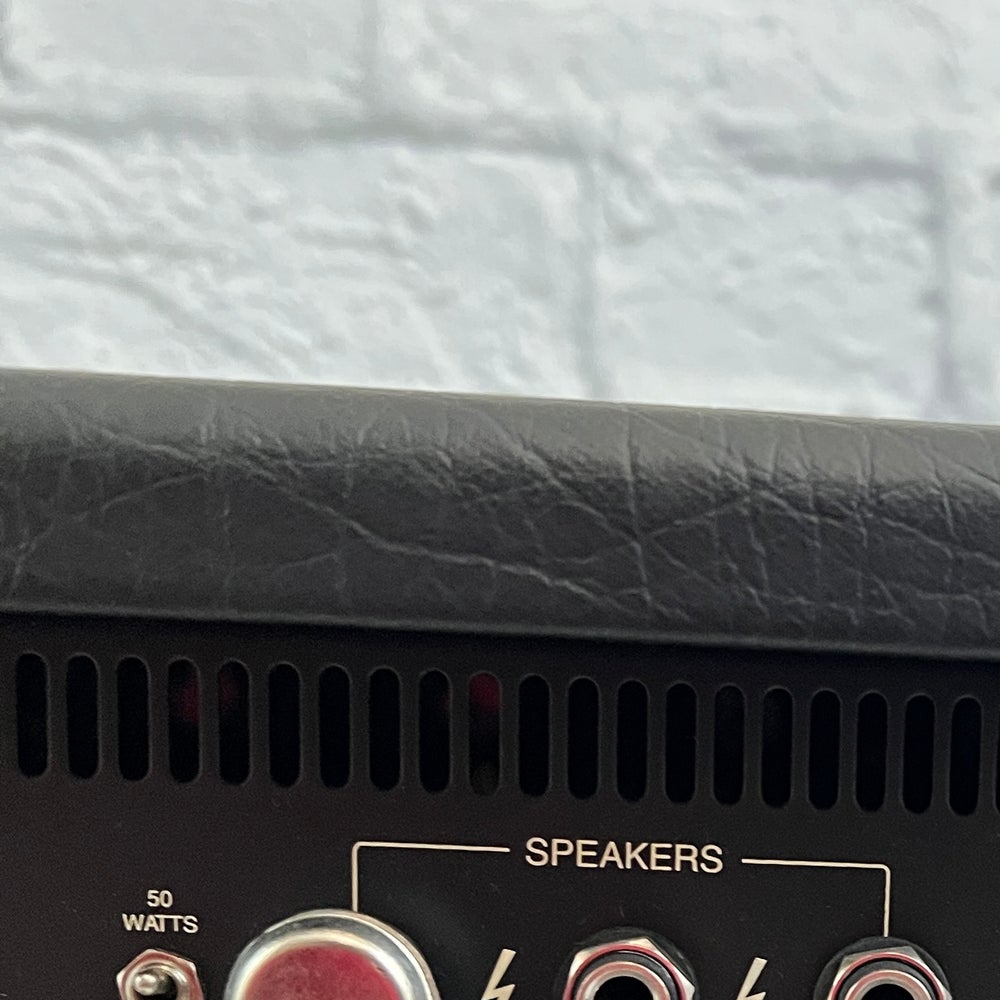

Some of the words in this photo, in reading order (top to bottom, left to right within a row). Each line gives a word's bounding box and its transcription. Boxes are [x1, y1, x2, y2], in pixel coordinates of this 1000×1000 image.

[525, 836, 723, 874] SPEAKERS
[146, 889, 173, 908] 50
[121, 913, 199, 934] WATTS
